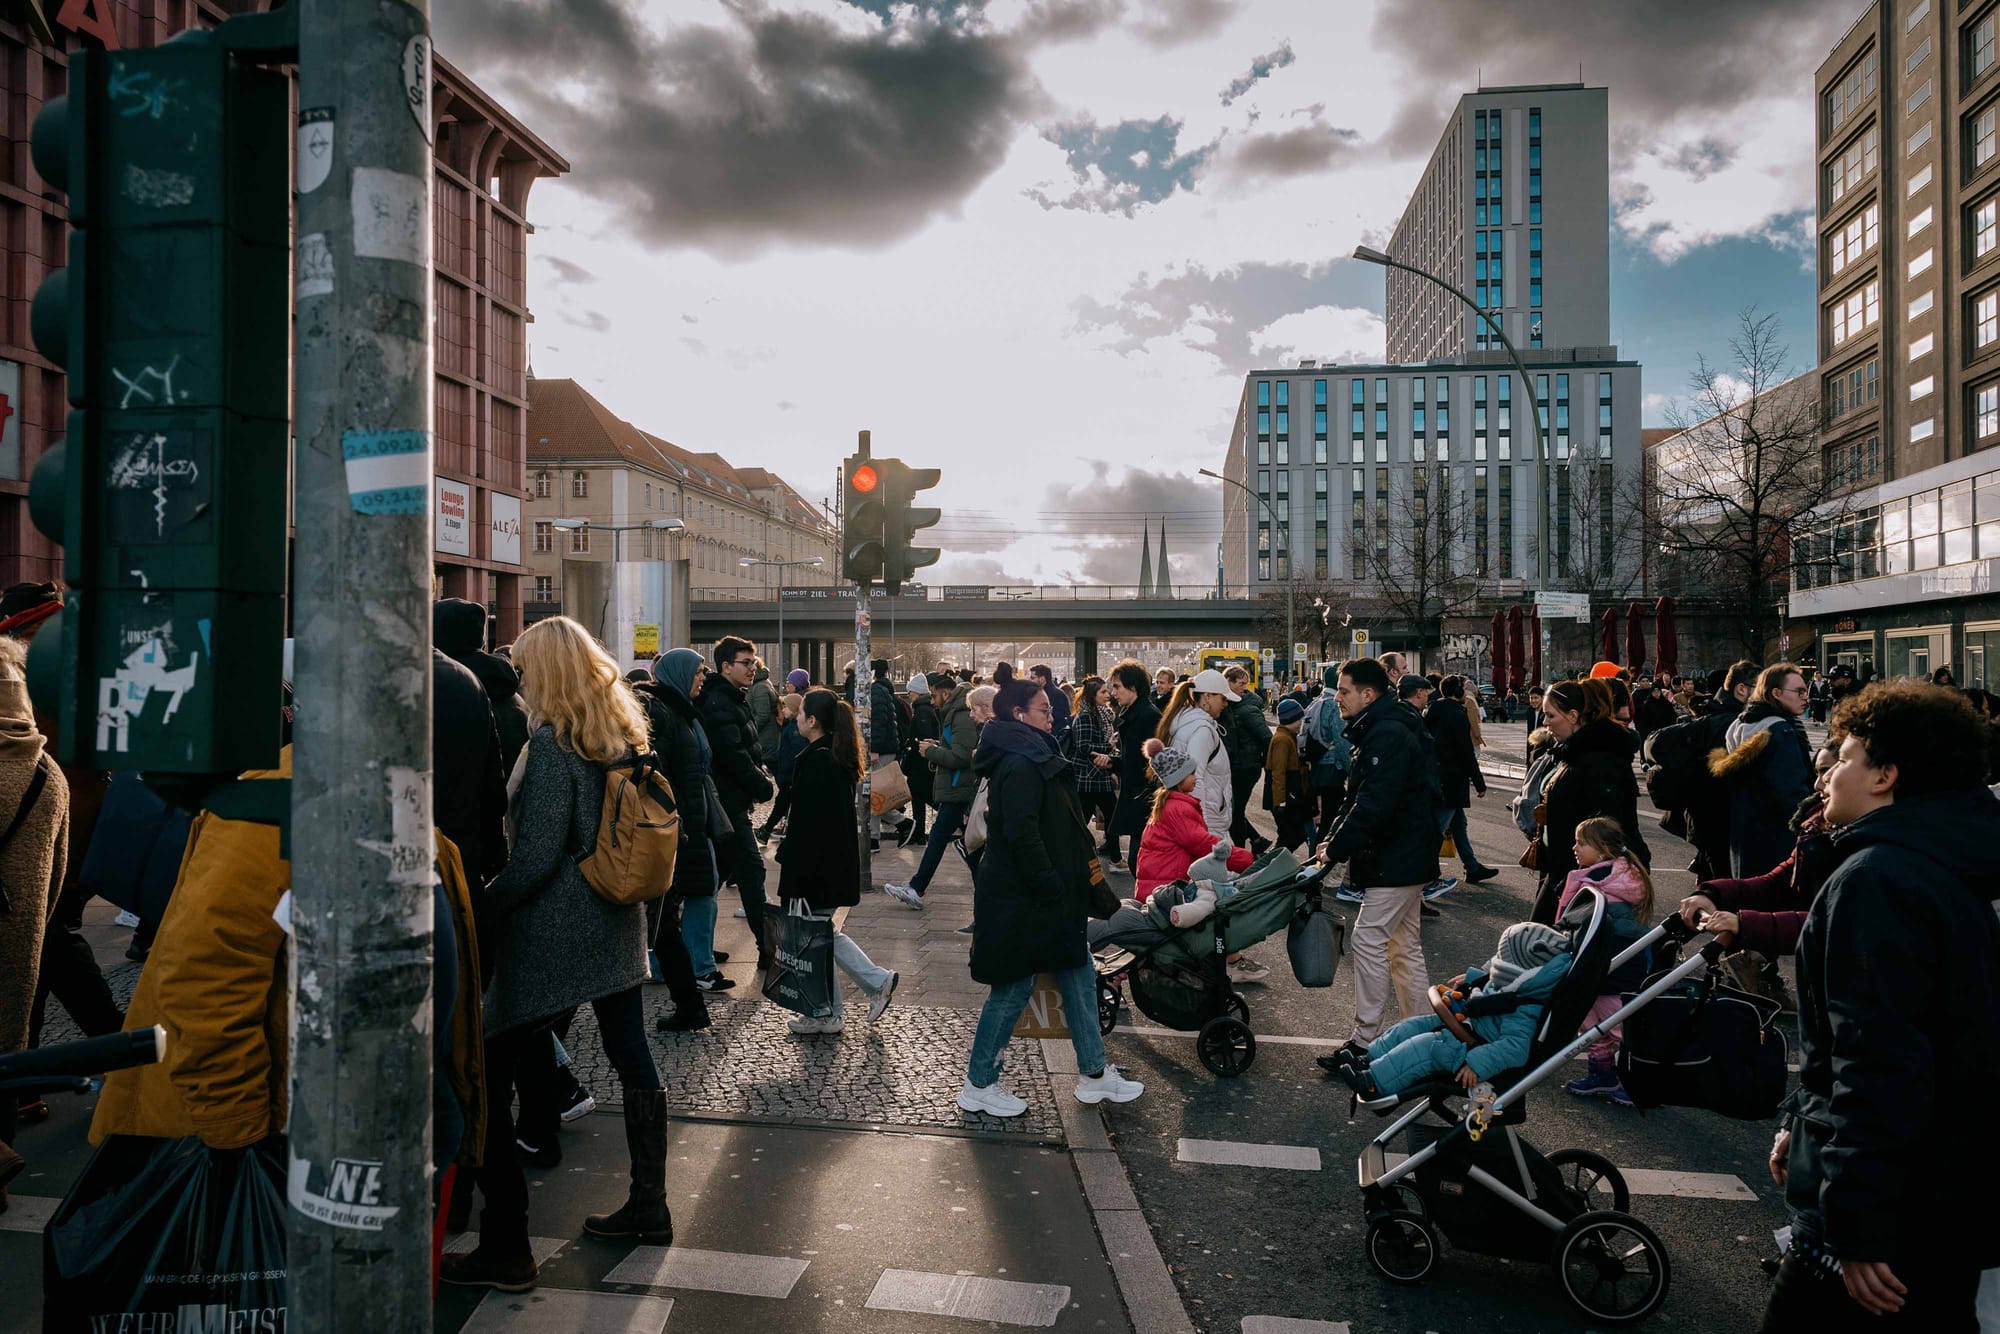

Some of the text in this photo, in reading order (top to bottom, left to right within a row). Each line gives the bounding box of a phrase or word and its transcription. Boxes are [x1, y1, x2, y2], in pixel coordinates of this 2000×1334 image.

[441, 487, 464, 505] Lounge
[441, 502, 465, 519] Bowling
[810, 590, 828, 598] ZIEL
[1215, 936, 1225, 954] Joie
[331, 1210, 359, 1225] DEINE
